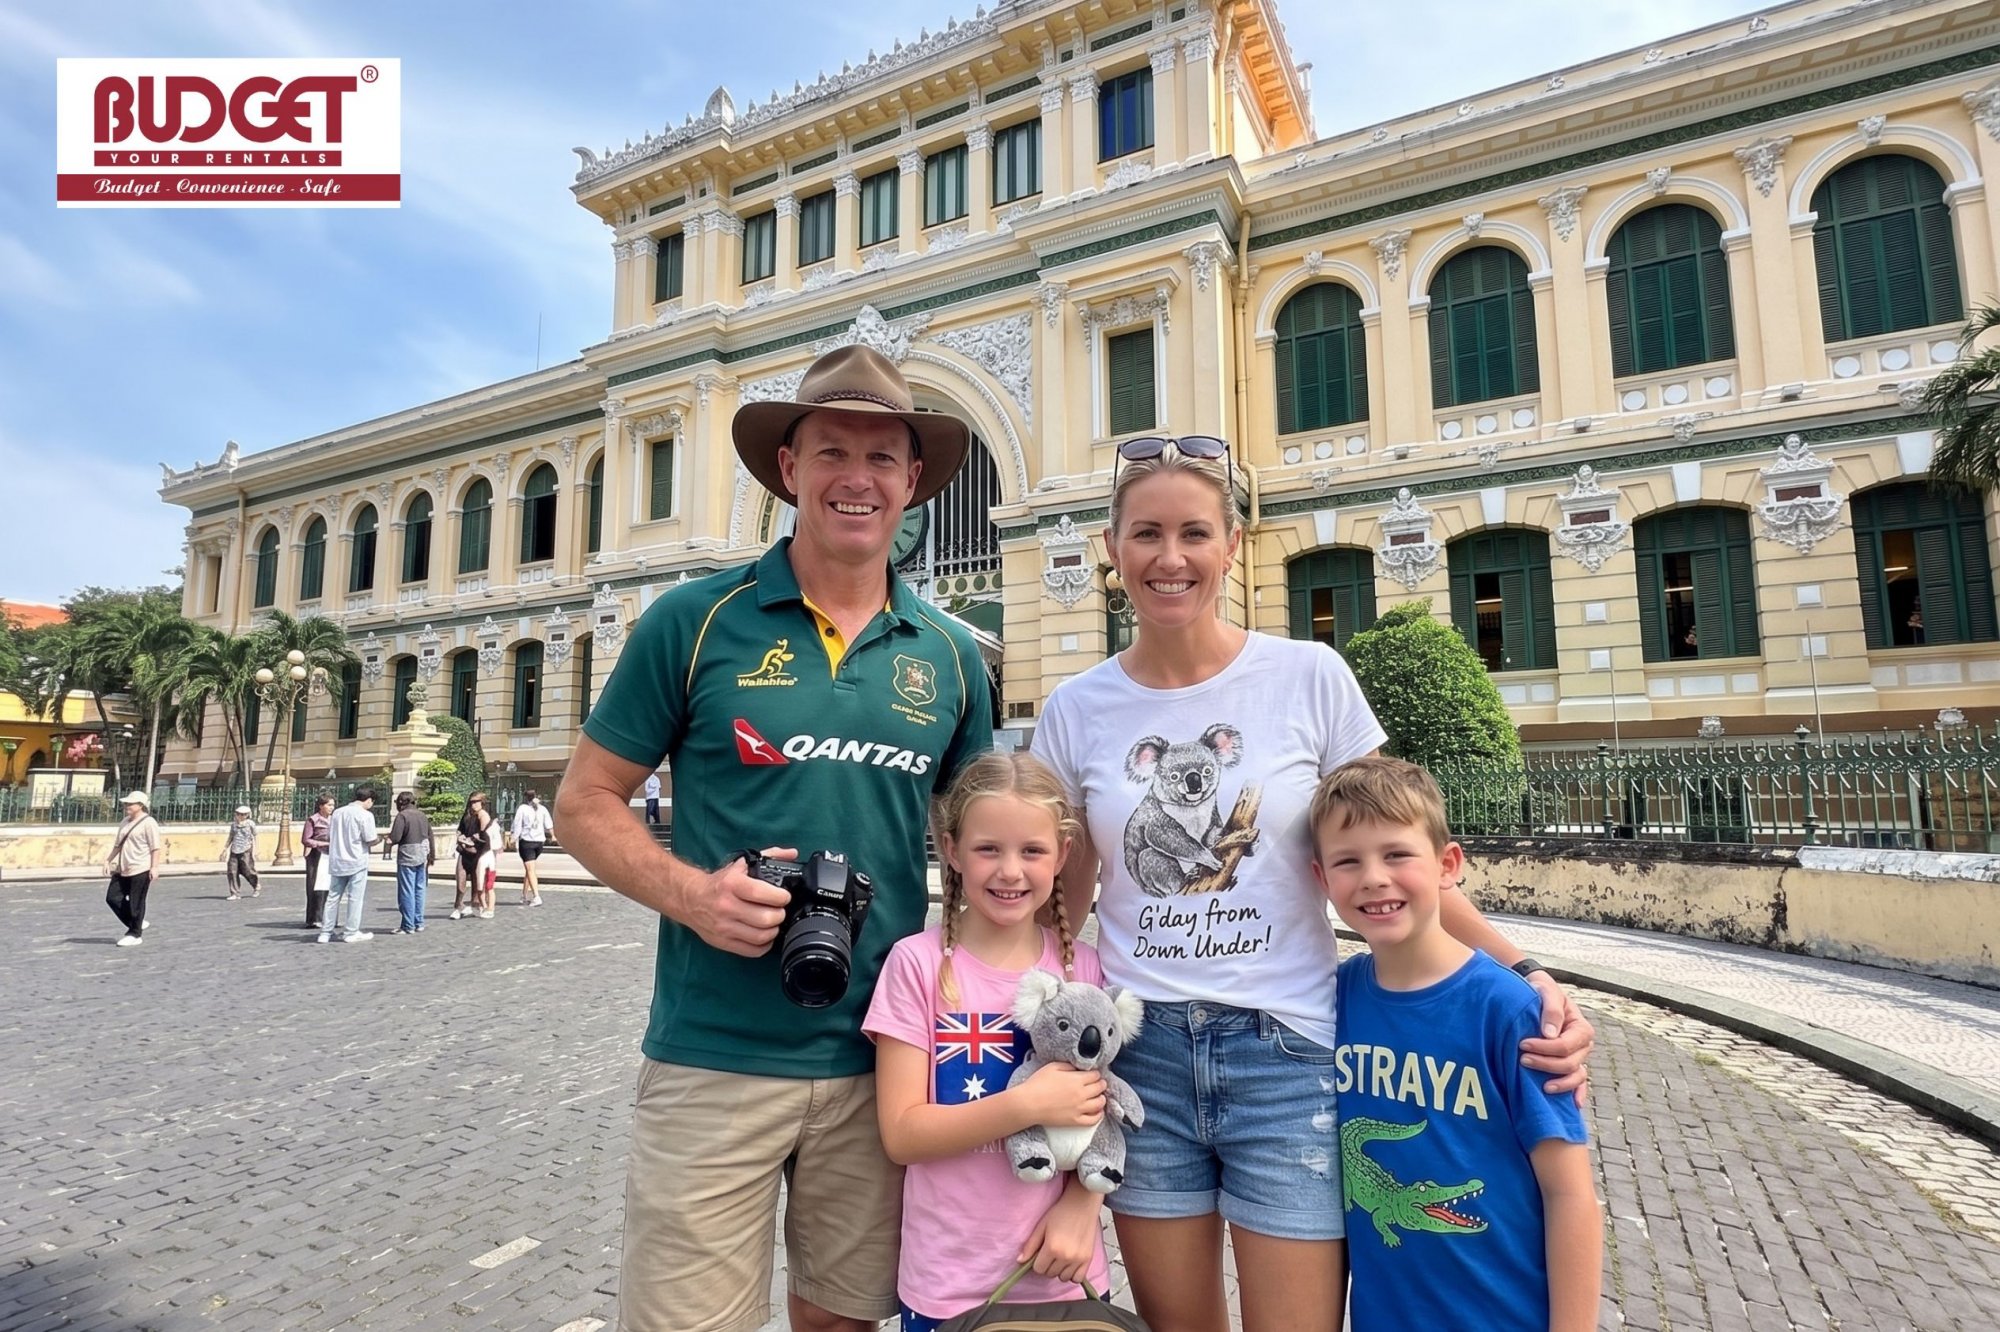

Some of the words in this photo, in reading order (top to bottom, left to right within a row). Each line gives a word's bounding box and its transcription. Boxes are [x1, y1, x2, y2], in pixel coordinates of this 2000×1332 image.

[782, 734, 932, 775] QANTAS
[1138, 905, 1197, 937] G'day
[1205, 898, 1262, 931] from
[1133, 936, 1188, 958] Down
[1195, 925, 1272, 958] Under!
[1335, 1044, 1488, 1120] STRAYA
